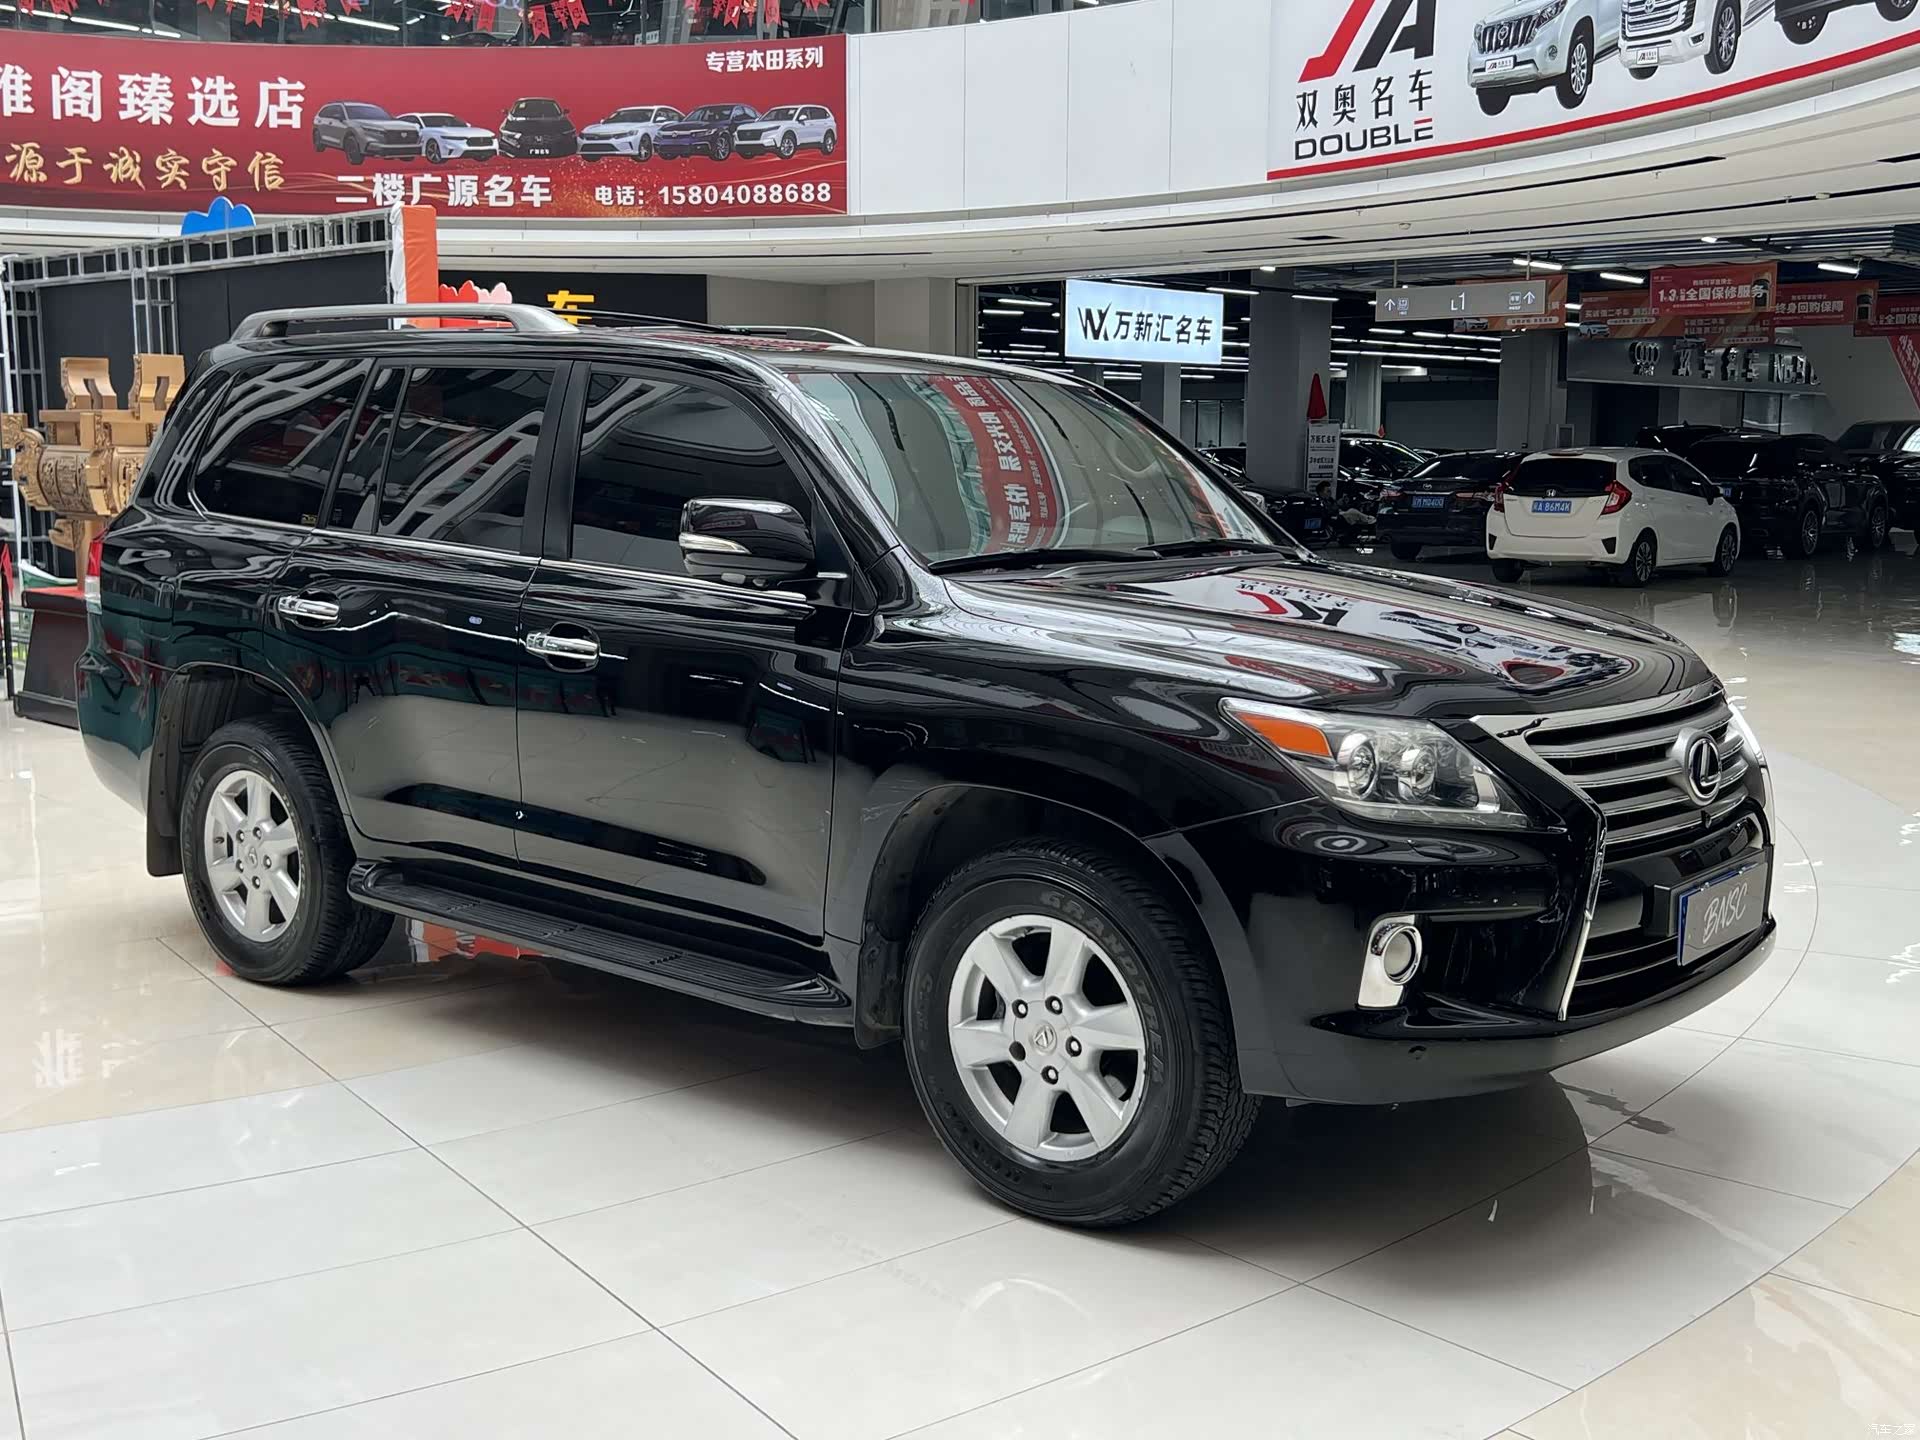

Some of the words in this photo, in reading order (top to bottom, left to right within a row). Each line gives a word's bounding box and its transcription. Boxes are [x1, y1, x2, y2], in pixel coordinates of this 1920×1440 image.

[706, 46, 824, 73] 专营本田系列
[0, 64, 305, 129] 雅阁臻选店
[1295, 69, 1433, 133] 双奥名车
[1295, 118, 1434, 160] DOUBLE
[5, 142, 286, 192] 源于诚实守信
[336, 173, 552, 207] 二楼广源名车
[658, 183, 831, 205] 15804088688
[1450, 292, 1466, 311] L1
[1113, 311, 1213, 345] 万新汇名车
